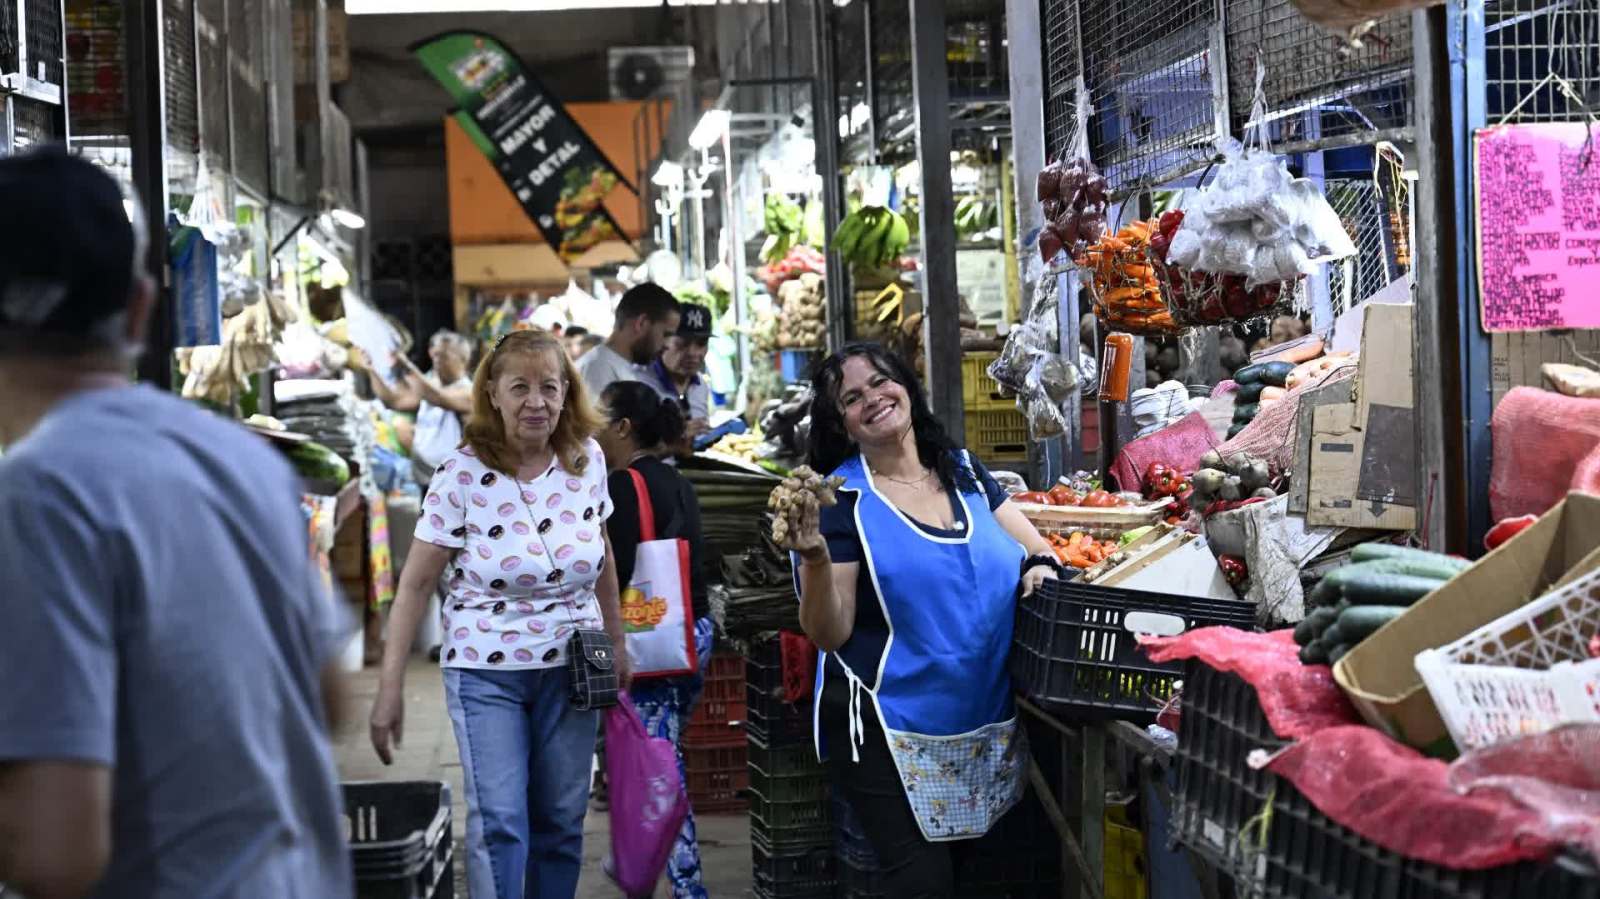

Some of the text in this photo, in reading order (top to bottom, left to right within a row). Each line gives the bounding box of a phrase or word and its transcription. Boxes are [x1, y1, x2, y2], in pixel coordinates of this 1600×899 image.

[501, 103, 556, 155] MAYOR
[532, 138, 548, 153] Y
[529, 141, 581, 186] DETAL
